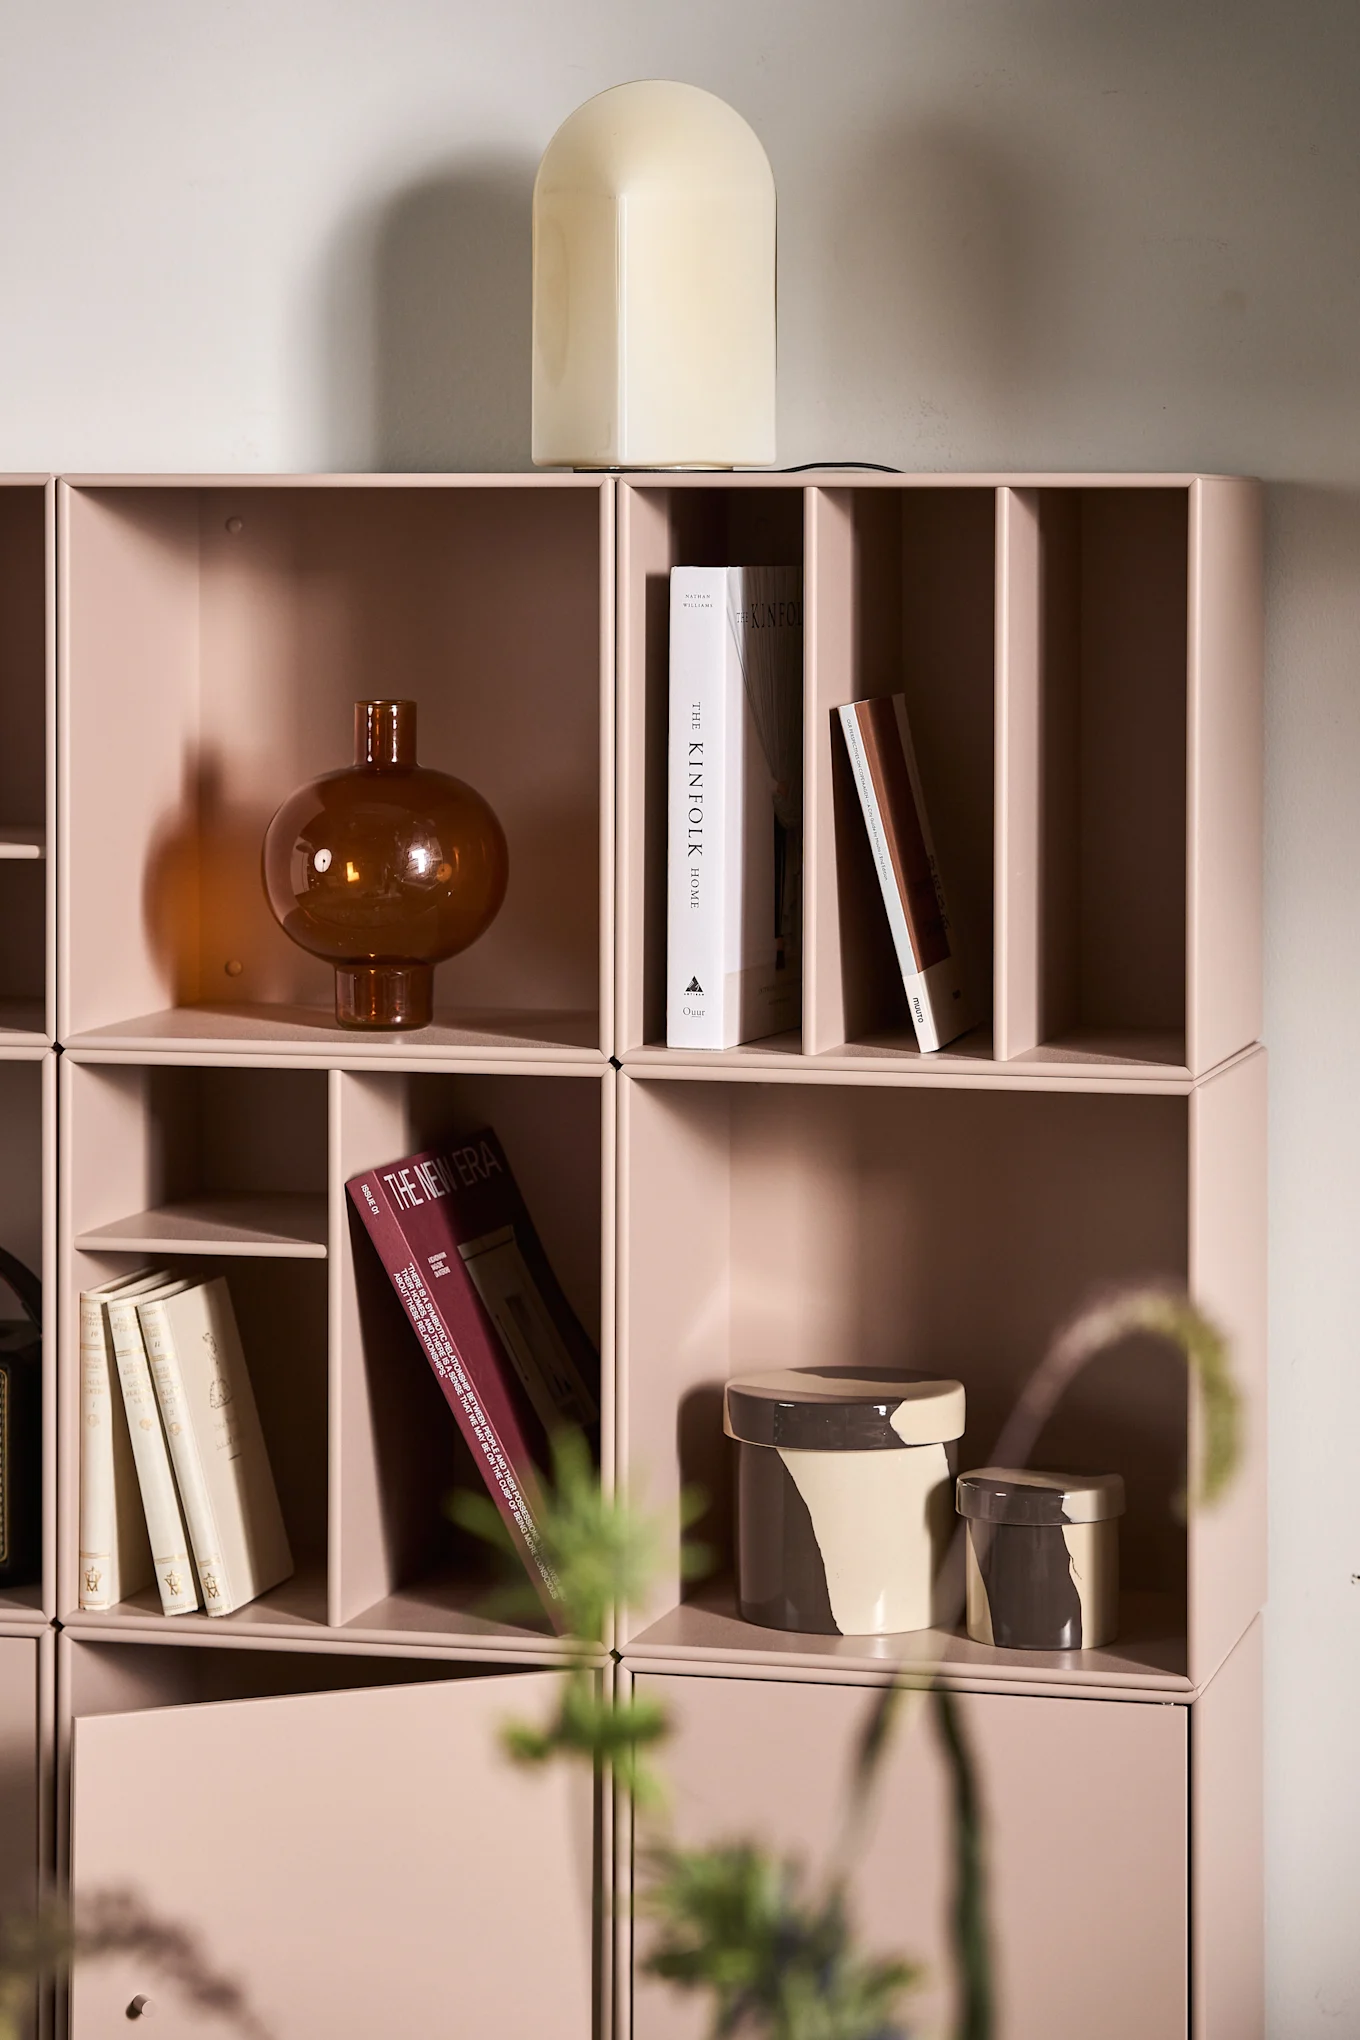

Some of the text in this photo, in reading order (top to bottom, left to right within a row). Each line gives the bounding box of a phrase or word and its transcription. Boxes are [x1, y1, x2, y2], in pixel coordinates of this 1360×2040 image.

[736, 602, 802, 628] THE KINFOL
[688, 702, 704, 909] THE KINFOLK HOME
[682, 1006, 706, 1017] Ouur
[361, 1184, 379, 1215] ISSUE 01
[383, 1140, 503, 1210] THE NEW ERA
[393, 1273, 410, 1296] ABOUT
[405, 1296, 420, 1321] THESE
[418, 1288, 426, 1296] IS
[424, 1302, 447, 1341] SYMBIOTIC
[442, 1341, 470, 1391] RELATIONSHIP
[466, 1391, 486, 1426] BETWEEN
[482, 1425, 499, 1454] PEOPLE
[494, 1454, 506, 1469] AND
[503, 1468, 516, 1491] THEIR
[400, 1267, 414, 1290] THEIR
[410, 1289, 426, 1318] HOMES,
[423, 1318, 434, 1333] AND
[431, 1332, 446, 1357] THERE
[441, 1356, 449, 1365] IS
[448, 1371, 464, 1395] SENSE
[459, 1394, 473, 1413] THAT
[468, 1413, 478, 1426] WE
[473, 1425, 486, 1441] MAY
[481, 1442, 490, 1453] BE
[486, 1452, 496, 1464] ON
[492, 1463, 503, 1480] THE
[498, 1479, 512, 1499] CUSP
[508, 1500, 518, 1510] OF
[513, 1510, 527, 1533] BEING
[523, 1533, 537, 1555] MORE
[534, 1556, 559, 1600] CONSCIOUS
